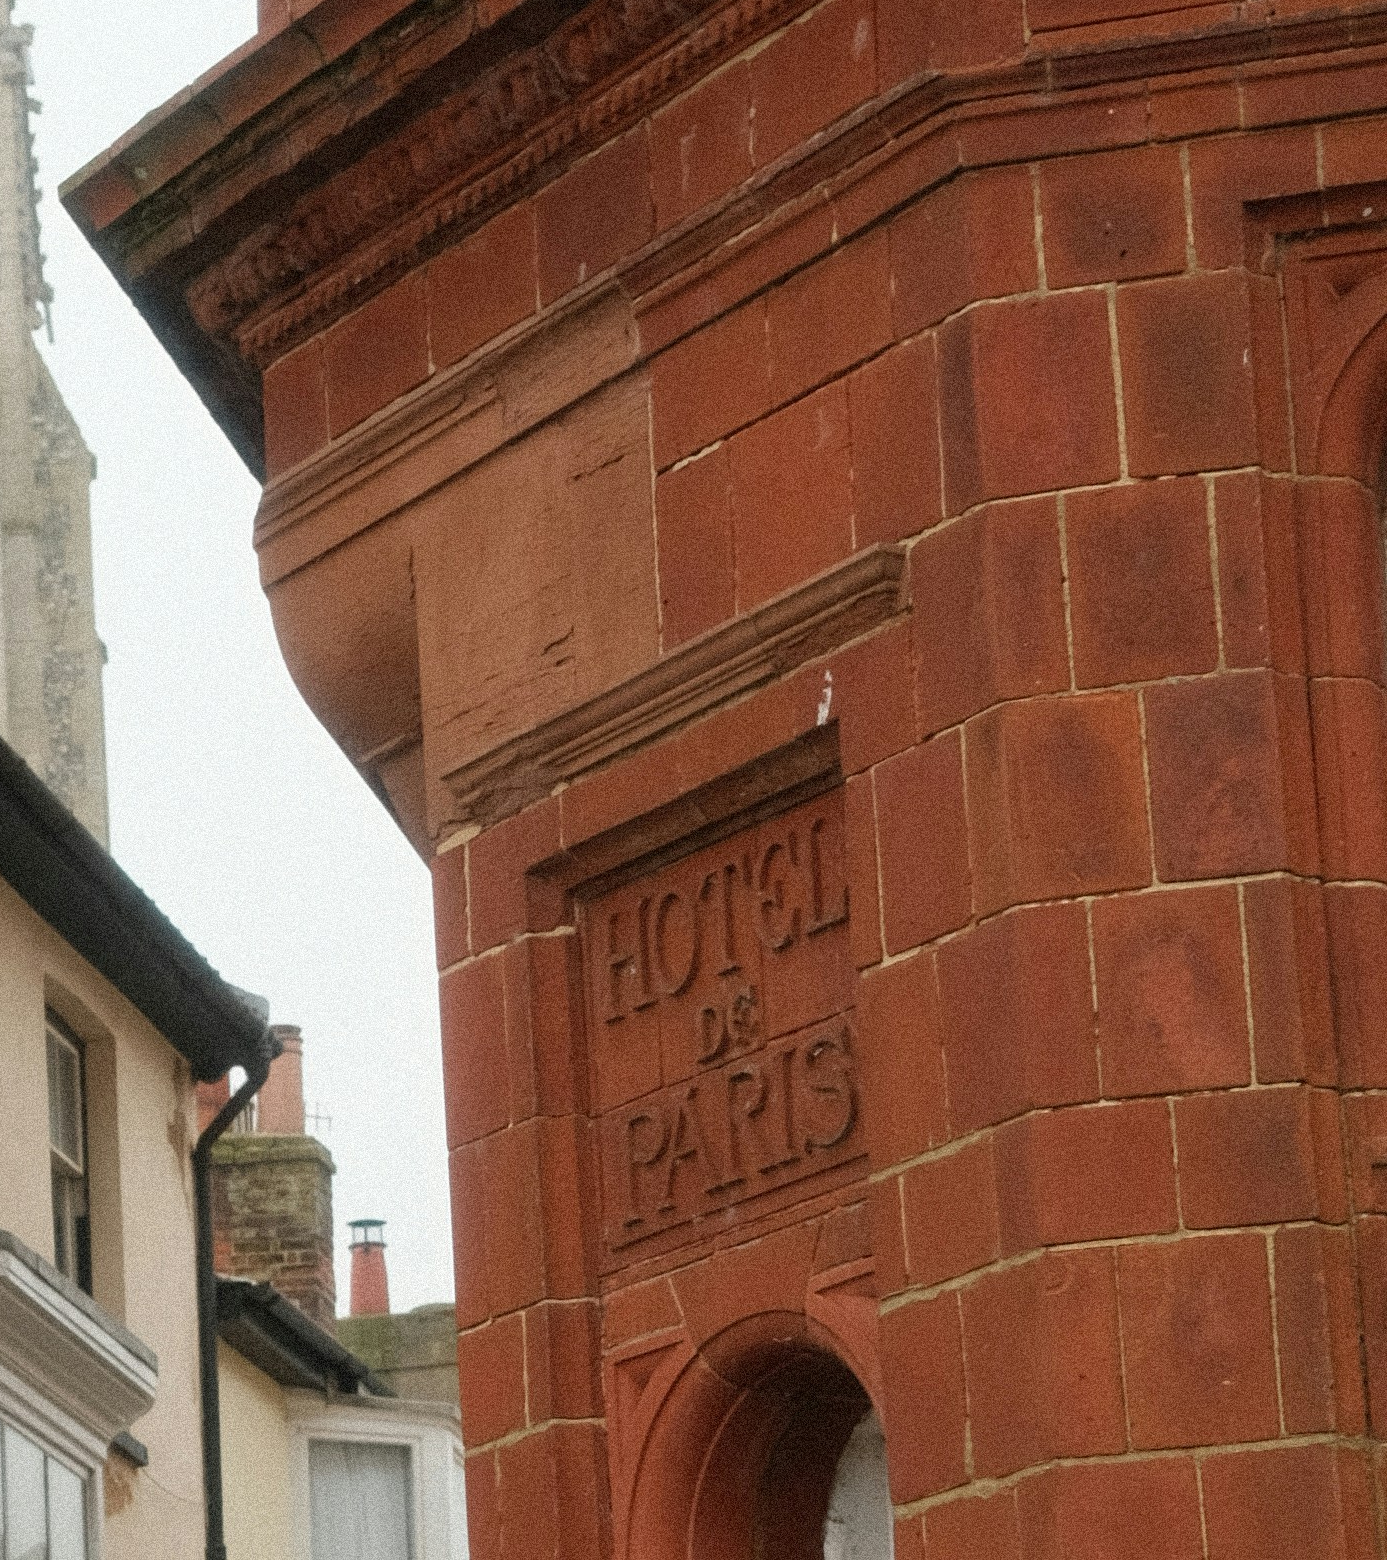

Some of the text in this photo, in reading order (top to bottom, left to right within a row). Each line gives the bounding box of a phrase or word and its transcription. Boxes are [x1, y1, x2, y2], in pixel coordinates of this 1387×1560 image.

[604, 818, 851, 1027] HOTEL
[698, 986, 762, 1066] DE
[623, 1028, 860, 1229] PARIS
